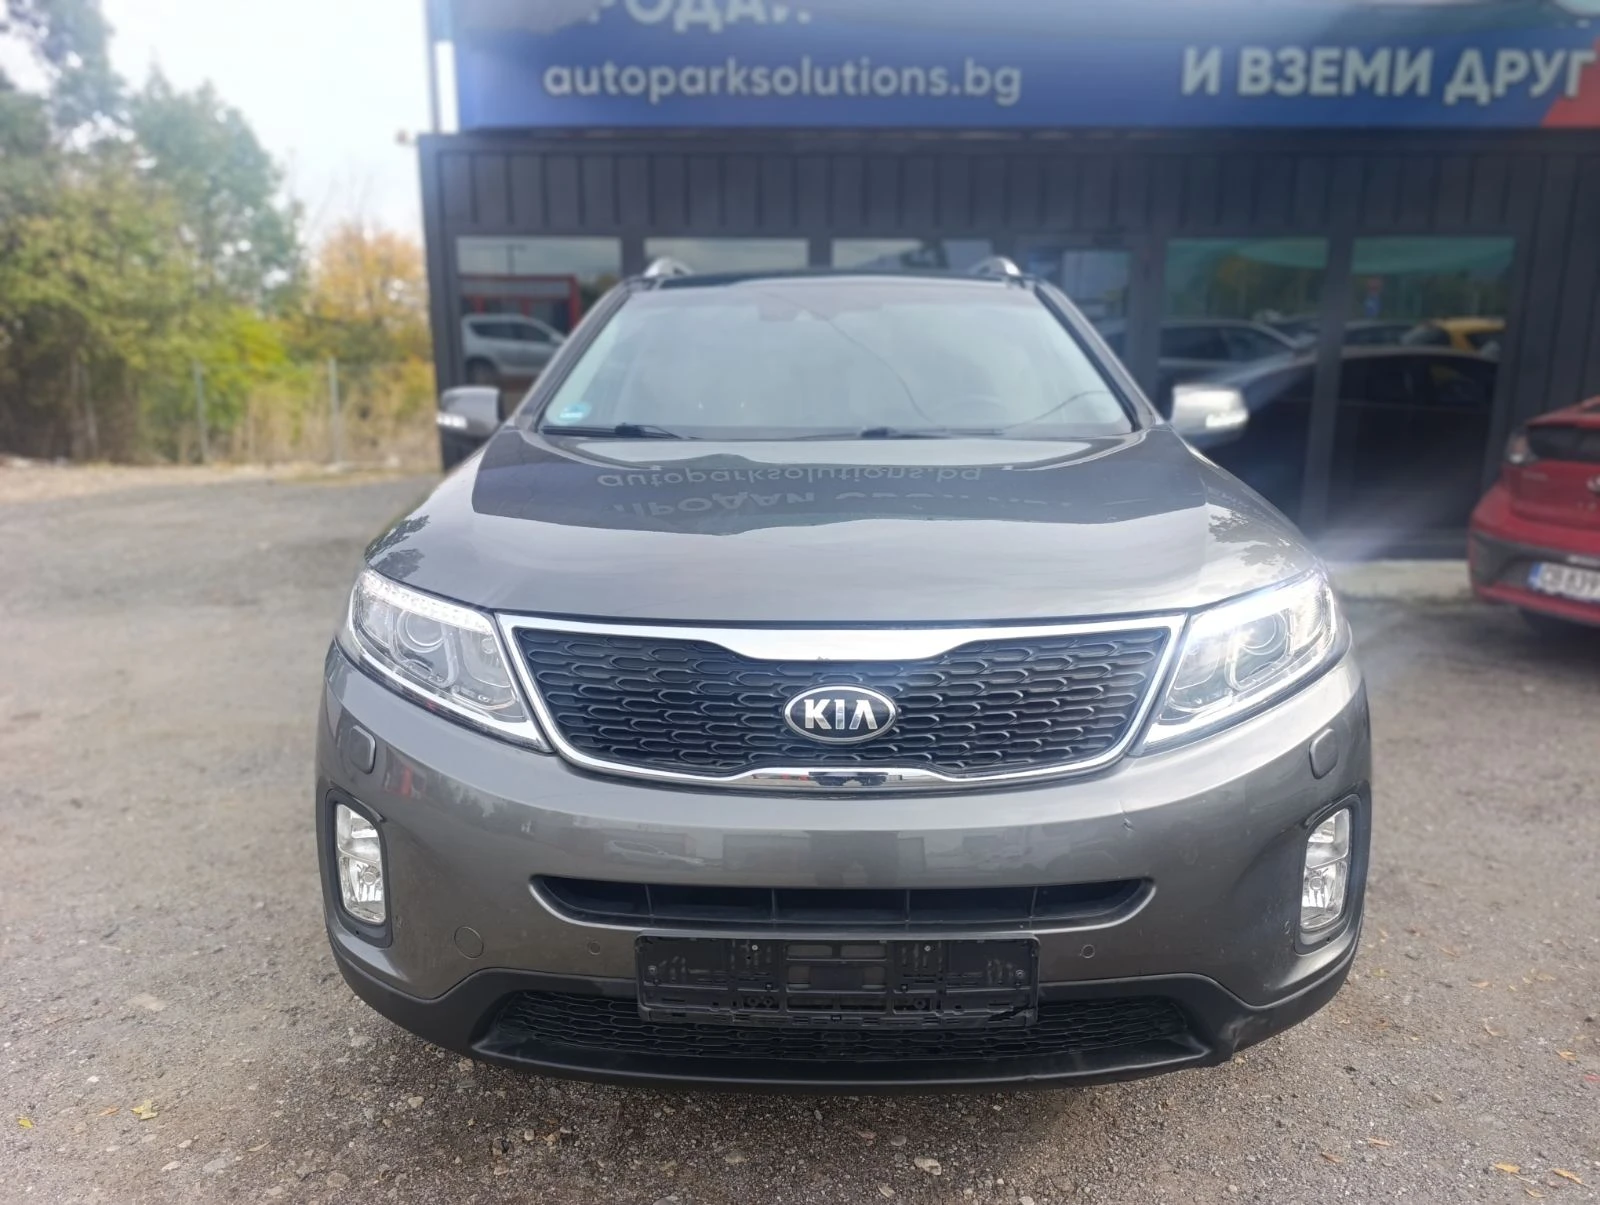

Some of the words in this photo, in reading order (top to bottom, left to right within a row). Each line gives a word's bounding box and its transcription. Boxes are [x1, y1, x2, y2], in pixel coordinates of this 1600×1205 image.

[543, 57, 1022, 105] autoparksolutions.bg
[1181, 47, 1221, 96] И
[1237, 47, 1433, 97] ВЗЕМИ
[1443, 49, 1597, 105] ДРУГ
[803, 698, 878, 730] KIA
